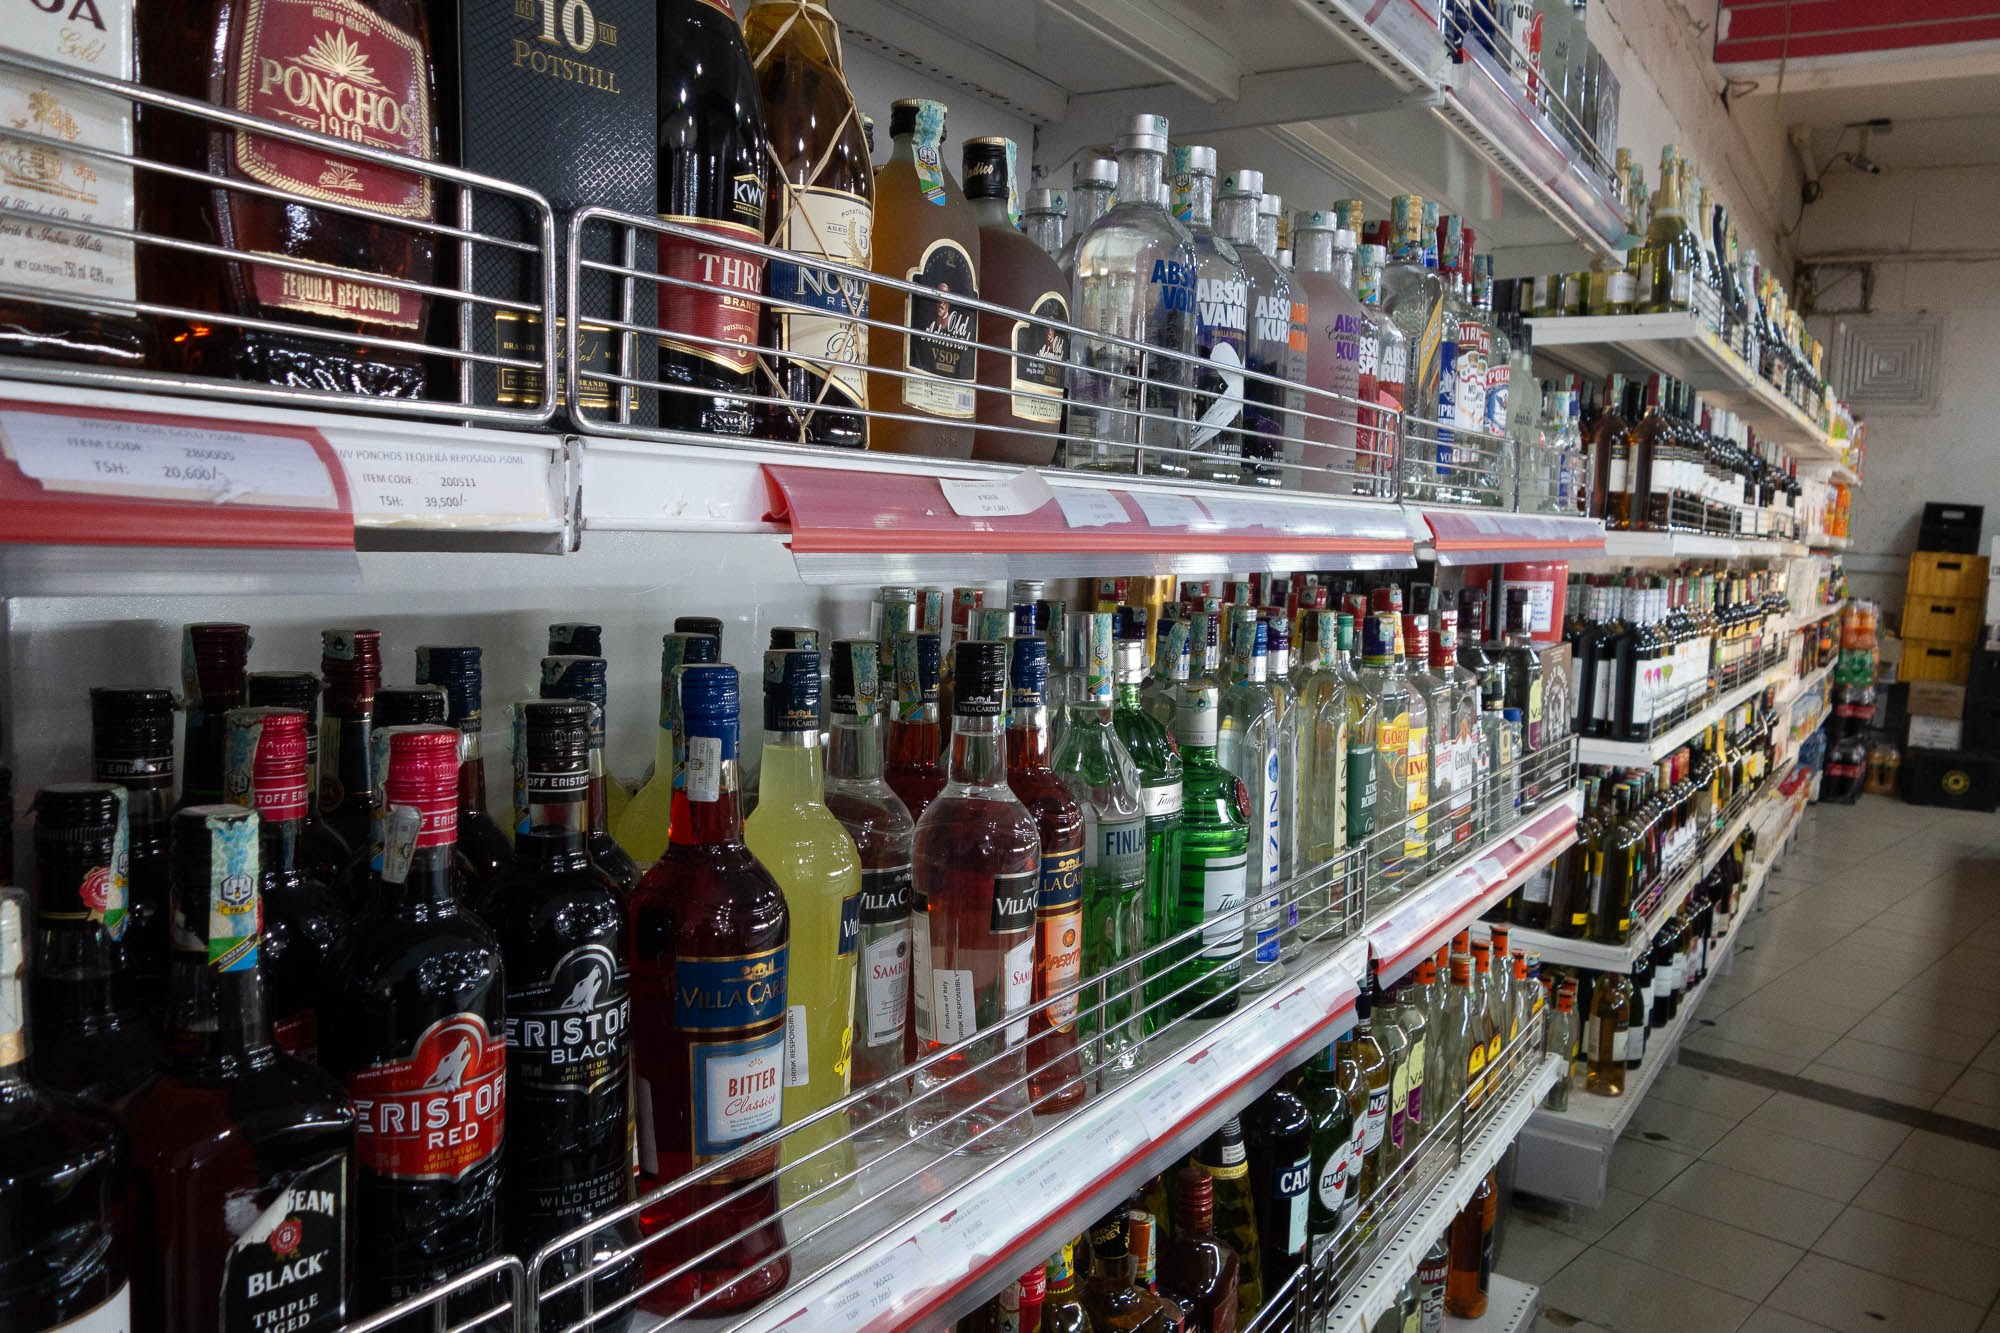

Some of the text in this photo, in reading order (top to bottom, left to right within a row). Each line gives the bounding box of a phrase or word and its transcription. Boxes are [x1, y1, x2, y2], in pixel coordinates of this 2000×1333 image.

[537, 0, 595, 53] 10
[513, 39, 620, 94] POTSTILL
[258, 56, 417, 139] PONCHOS
[283, 272, 400, 314] TEQUILA REPOSADO
[931, 347, 960, 367] VSOP
[356, 450, 401, 461] PONCHOS
[450, 455, 496, 464] REPOSADO
[363, 474, 386, 484] ITEM
[441, 477, 477, 487] 200511
[682, 985, 744, 1009] VILLA
[788, 1008, 796, 1058] RESPONSIBLY
[551, 1037, 617, 1064] BLACK
[728, 1067, 776, 1098] BITTER
[353, 1069, 506, 1134] ERISTOF
[428, 1122, 479, 1150] RED
[424, 1156, 454, 1171] SPIRIT
[428, 1142, 479, 1162] PREMIUM
[565, 1171, 614, 1192] IMPORTED
[540, 1193, 583, 1207] WILD
[557, 1203, 592, 1216] SPIRIT
[248, 1251, 322, 1298] BLACK
[252, 1293, 318, 1329] TRIPLE
